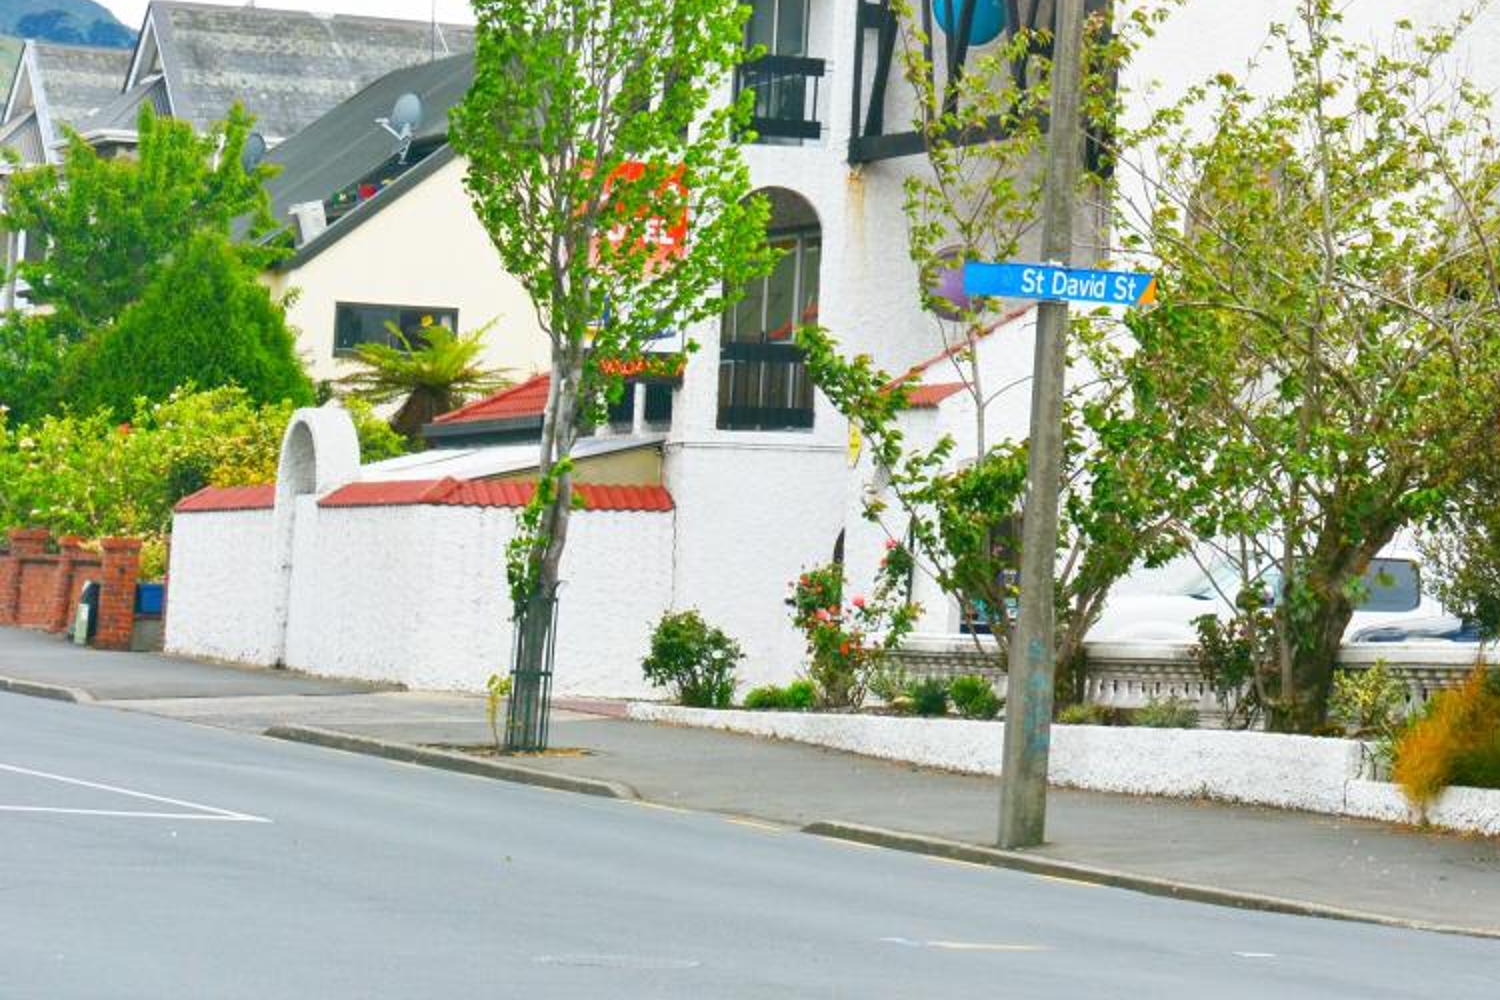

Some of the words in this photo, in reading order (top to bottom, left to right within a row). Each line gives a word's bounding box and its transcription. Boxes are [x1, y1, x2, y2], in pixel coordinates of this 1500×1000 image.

[1021, 268, 1045, 295] St
[1052, 271, 1107, 299] David
[1113, 276, 1137, 301] St
